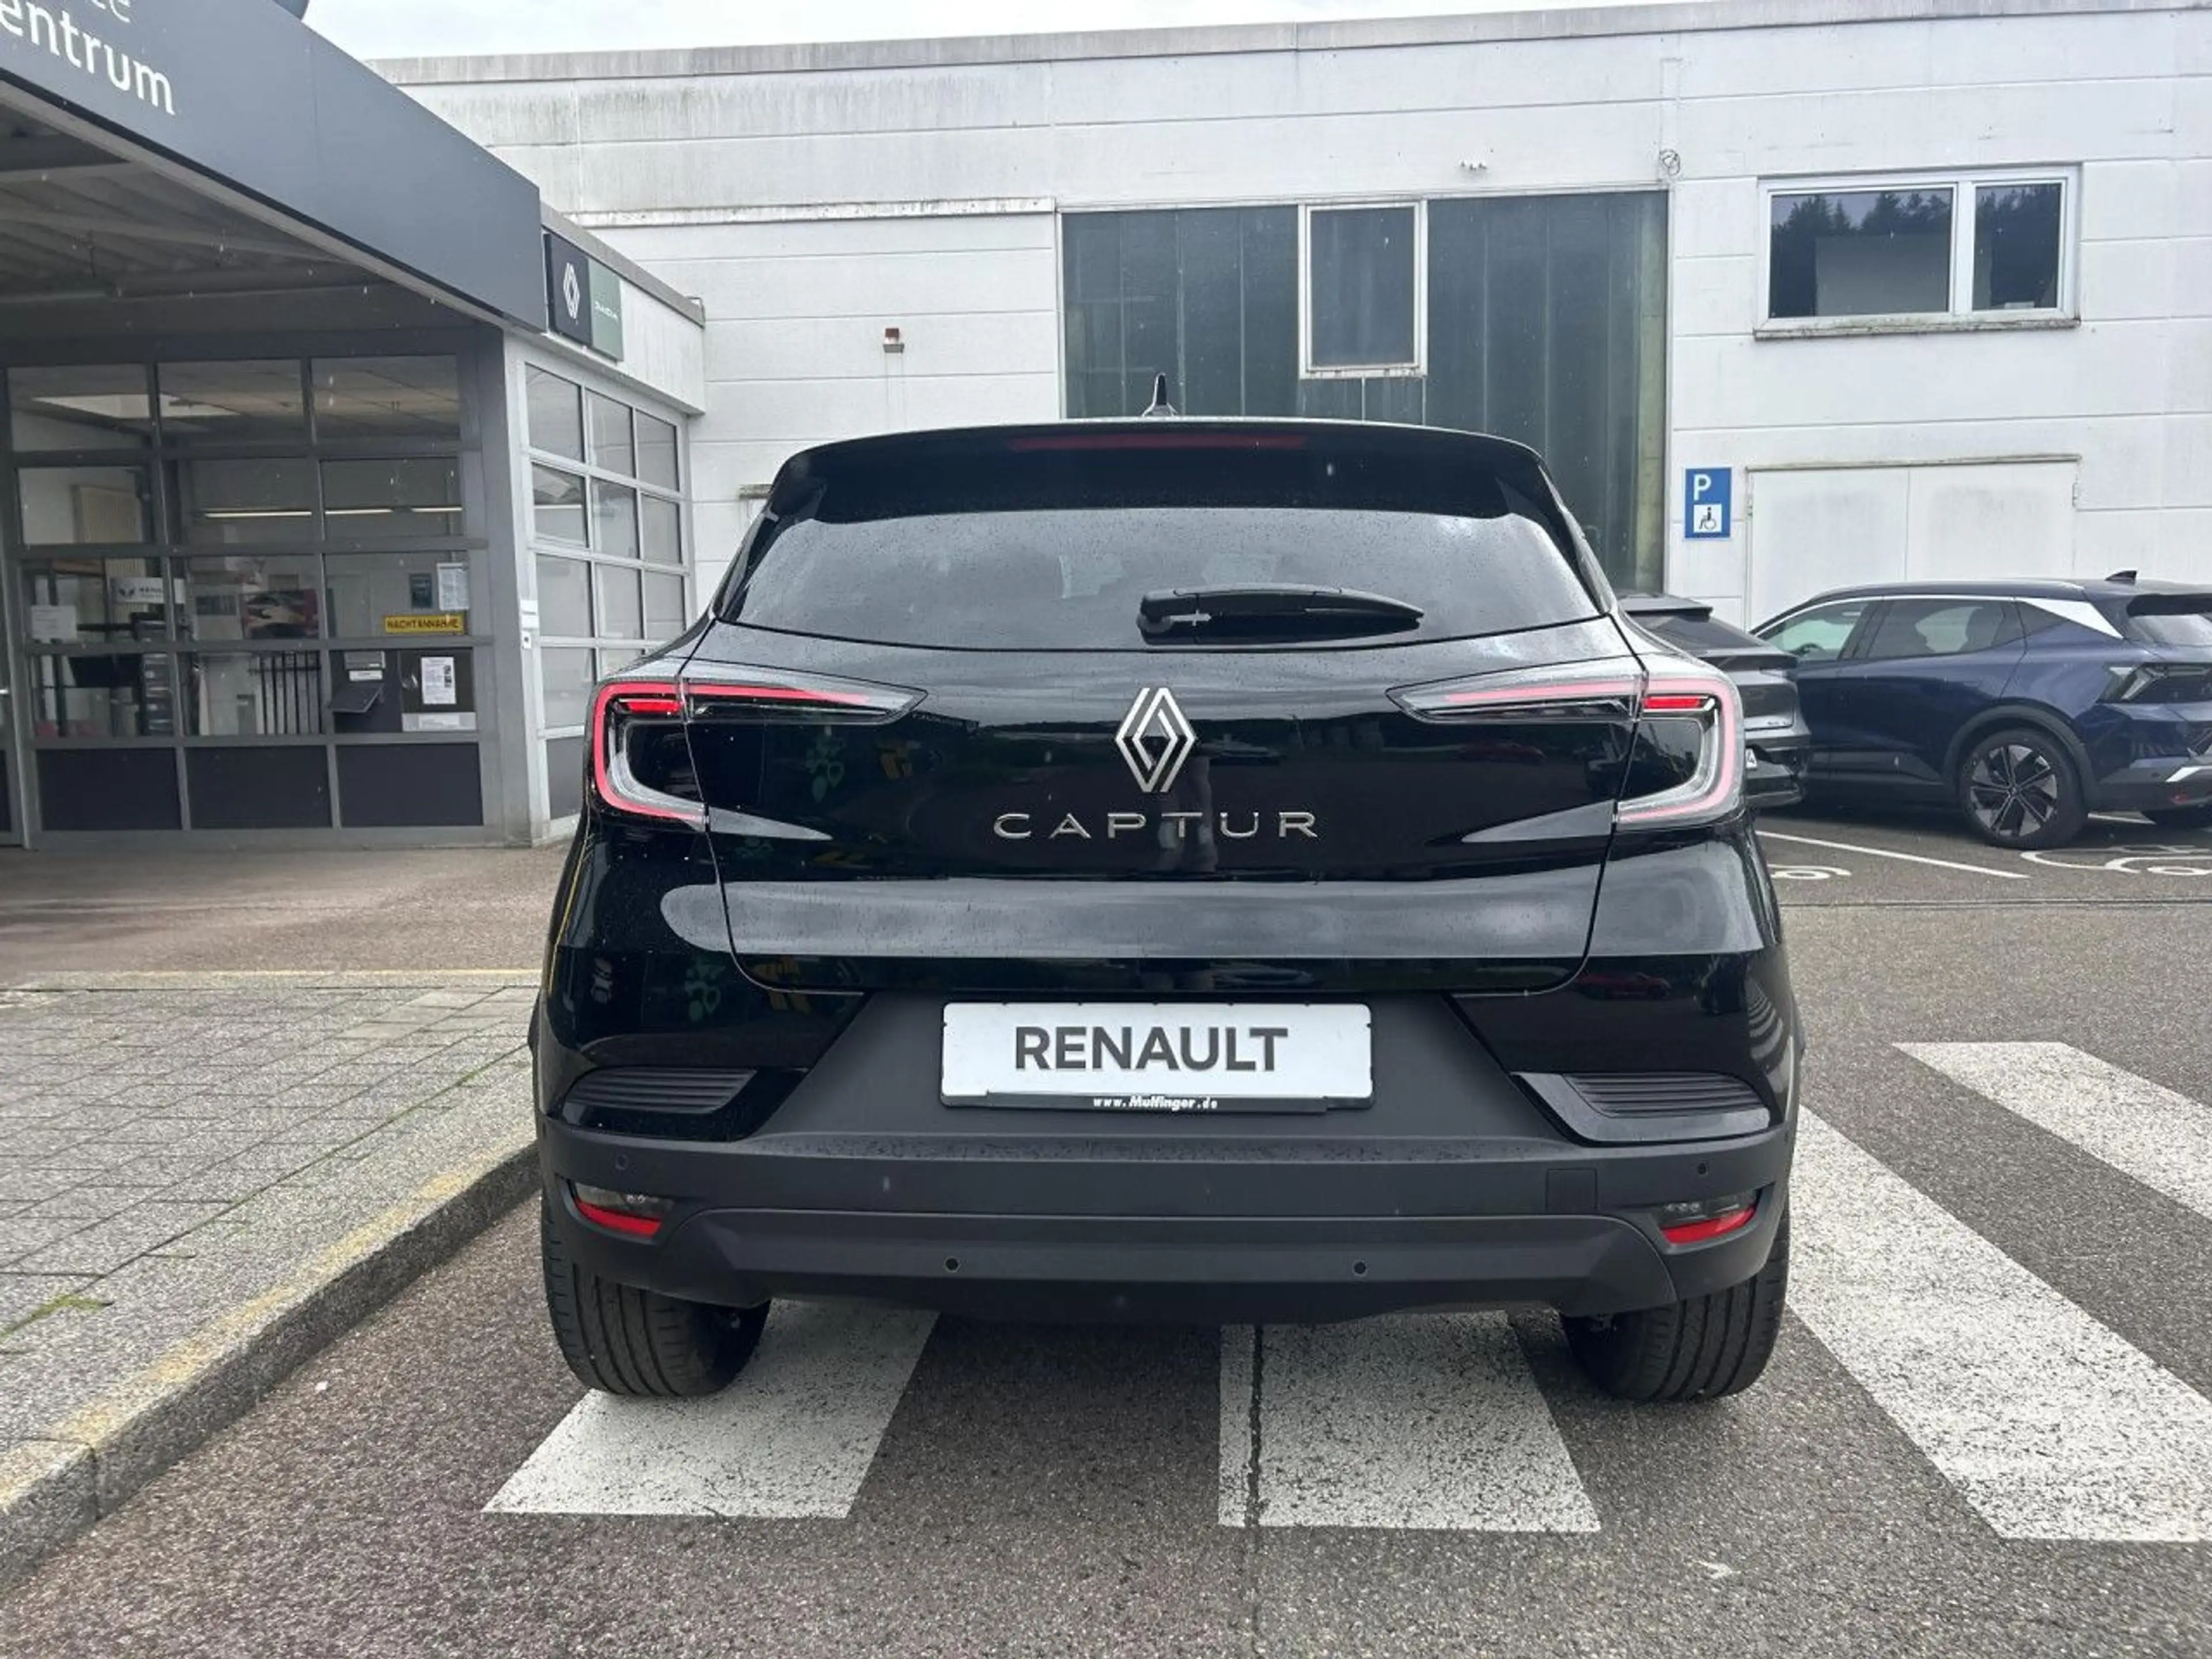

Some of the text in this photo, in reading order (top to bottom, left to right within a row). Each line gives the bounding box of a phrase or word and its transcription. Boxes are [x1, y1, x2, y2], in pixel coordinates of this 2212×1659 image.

[1693, 474, 1712, 501] P
[993, 812, 1319, 839] CAPTUR
[1015, 1026, 1289, 1073] RENAULT
